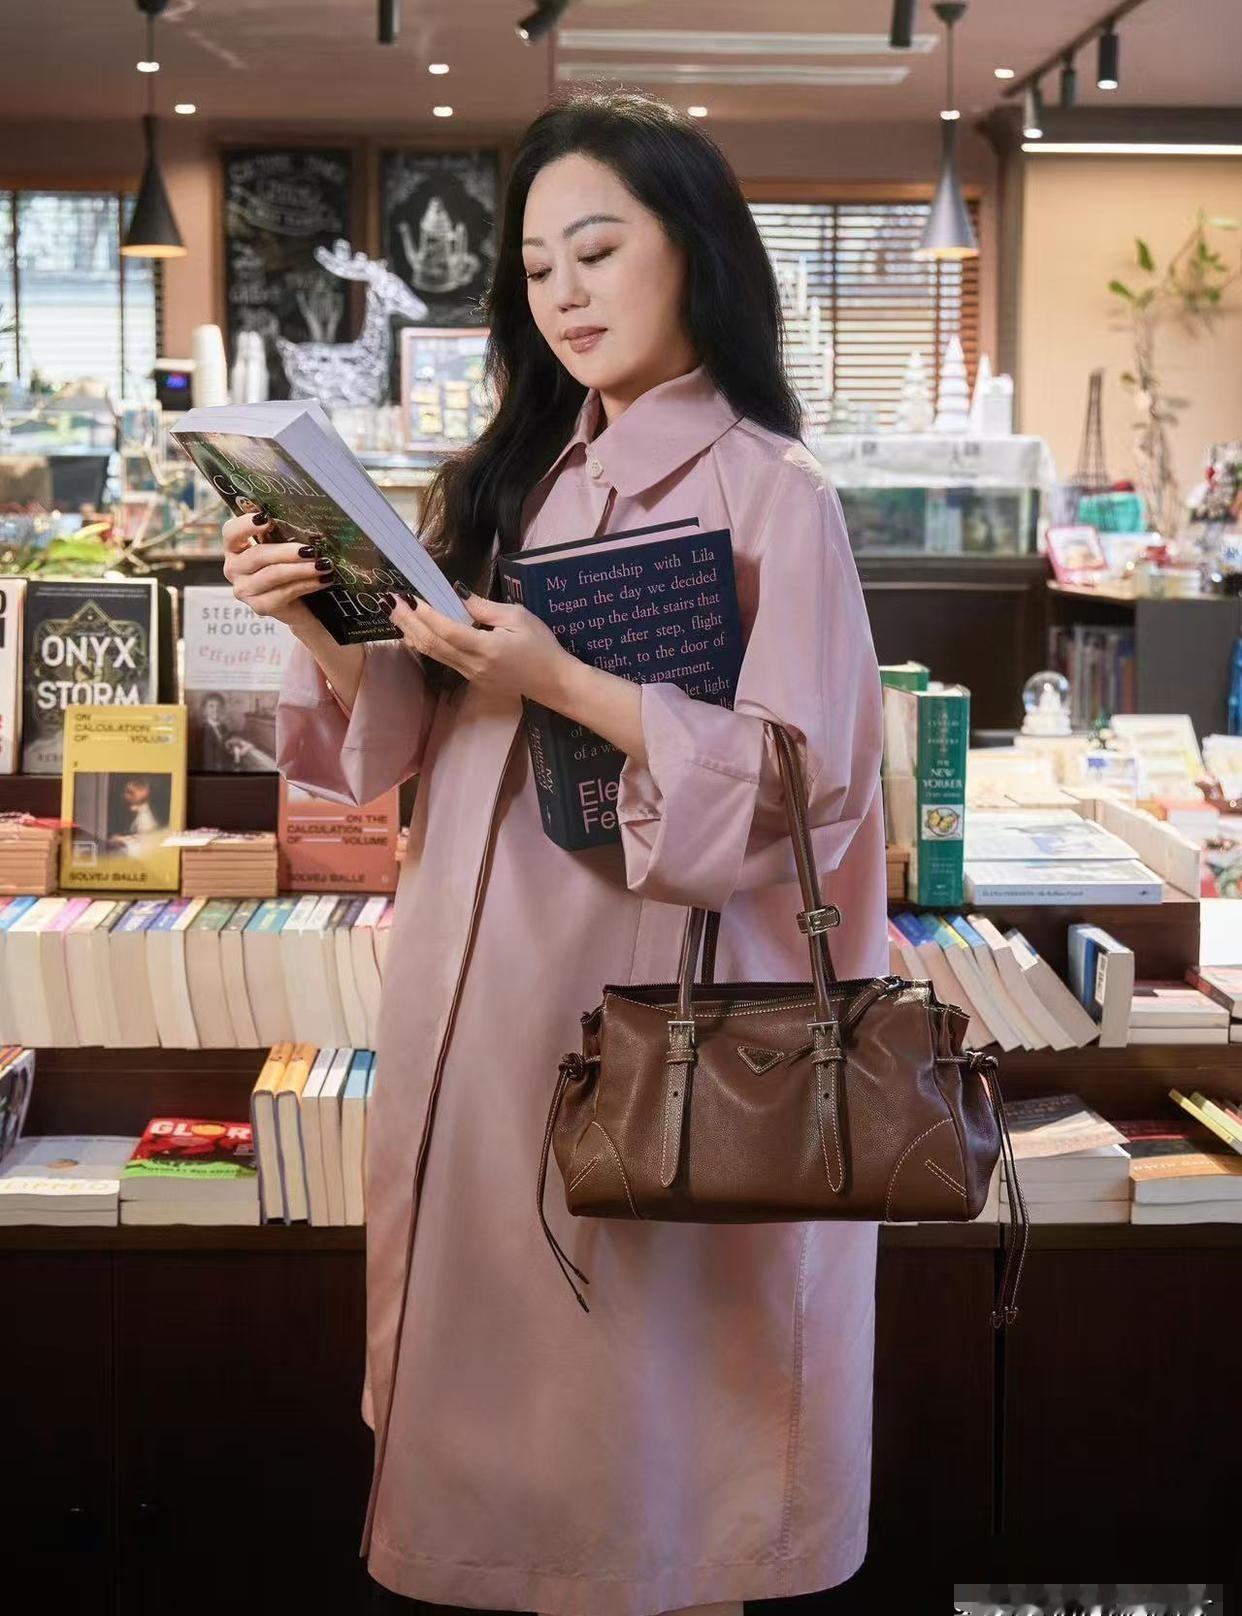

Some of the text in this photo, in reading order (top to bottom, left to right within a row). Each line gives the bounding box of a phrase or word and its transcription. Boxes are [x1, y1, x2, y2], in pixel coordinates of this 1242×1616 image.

[546, 547, 715, 591] My friendship with Lila
[549, 568, 717, 613] began the day we decided
[202, 607, 256, 620] STEPH
[552, 592, 720, 635] to go up the dark stairs that
[207, 622, 275, 635] HOUGH
[587, 637, 614, 651] step
[620, 628, 649, 644] after
[656, 624, 686, 638] step,
[691, 612, 723, 631] flight
[41, 634, 137, 668] ONYX
[595, 632, 727, 671] flight, to the door of
[650, 661, 715, 683] apartment.
[704, 676, 730, 695] light
[37, 681, 140, 710] STORM
[74, 723, 149, 733] CALCULATION
[574, 743, 587, 760] of
[591, 747, 598, 757] a
[930, 768, 956, 777] NEW
[579, 778, 619, 807] Ele
[922, 779, 963, 789] YORKER
[346, 815, 388, 824] ON THE
[583, 807, 616, 834] Fe
[287, 825, 363, 835] CALCULATION
[287, 835, 388, 847] OF VOLUME
[112, 872, 148, 882] BALLE
[330, 873, 367, 884] BALLE
[150, 1119, 251, 1140] GLOR
